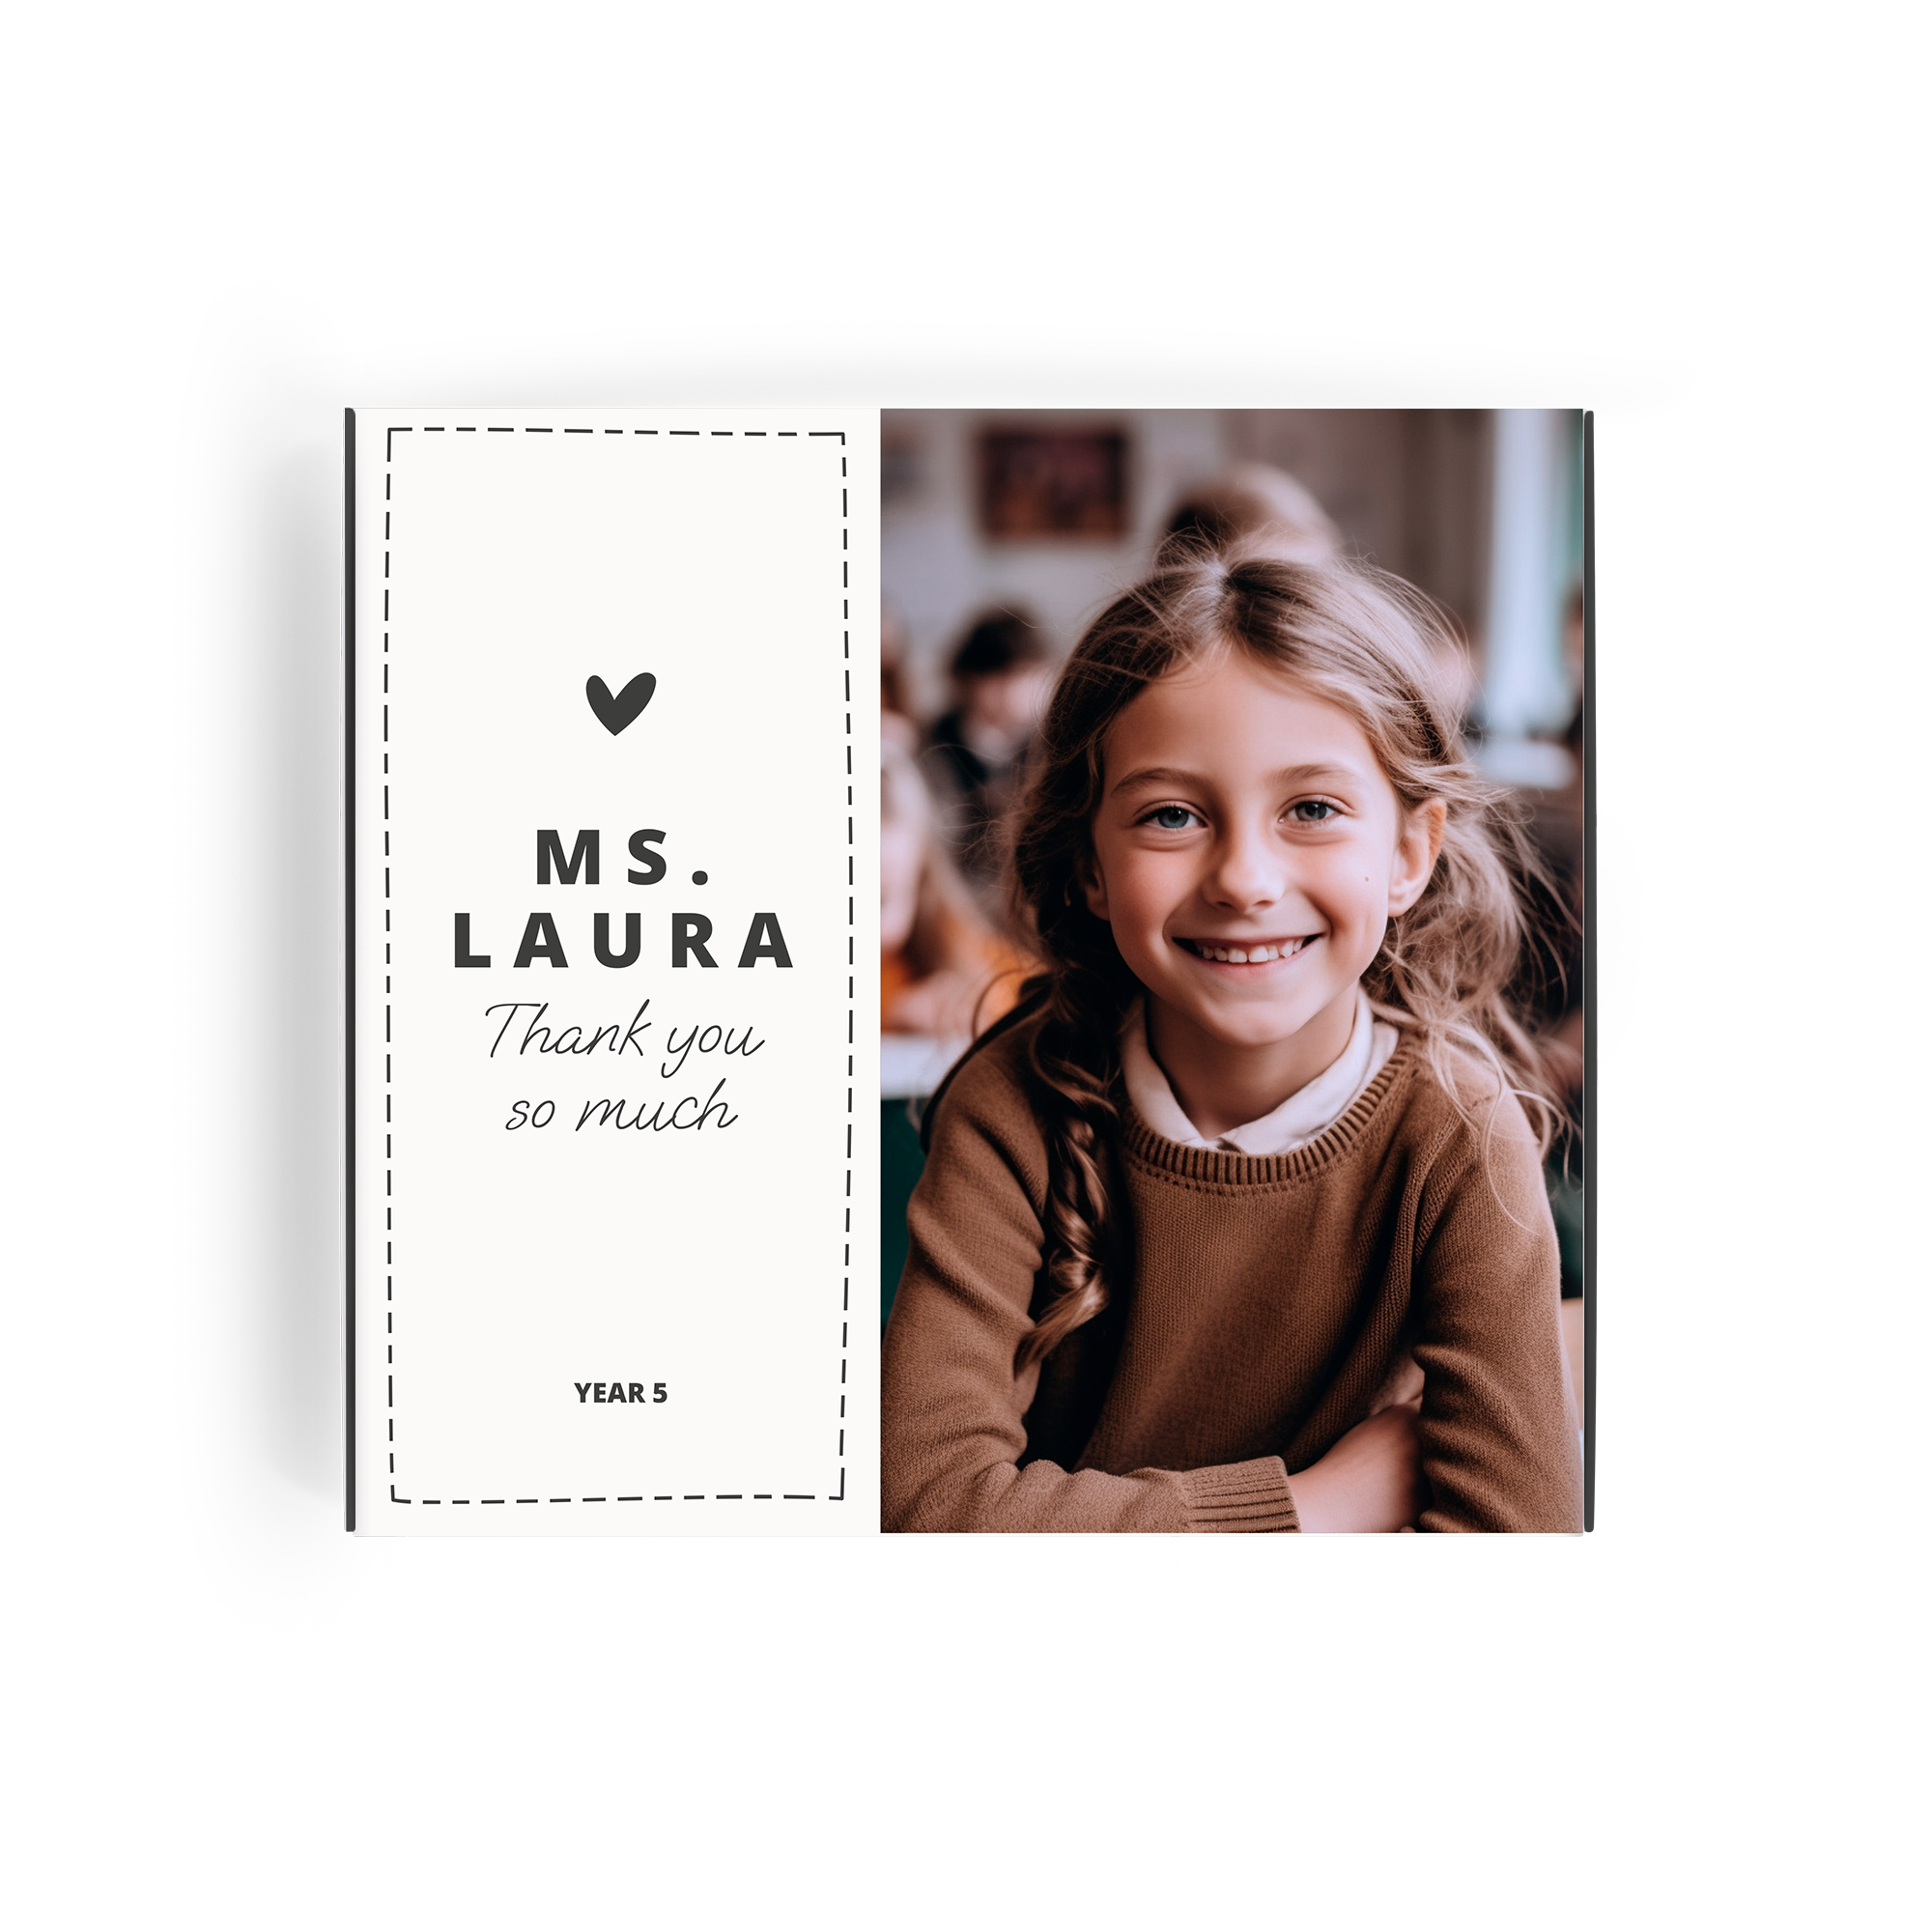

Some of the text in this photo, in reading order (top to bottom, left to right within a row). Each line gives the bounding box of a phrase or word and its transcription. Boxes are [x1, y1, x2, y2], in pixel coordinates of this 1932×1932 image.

[536, 828, 709, 886] MS.
[454, 912, 794, 970] LAURA
[484, 998, 766, 1079] Thank you
[504, 1077, 739, 1132] so much
[573, 1382, 668, 1404] YEAR 5
